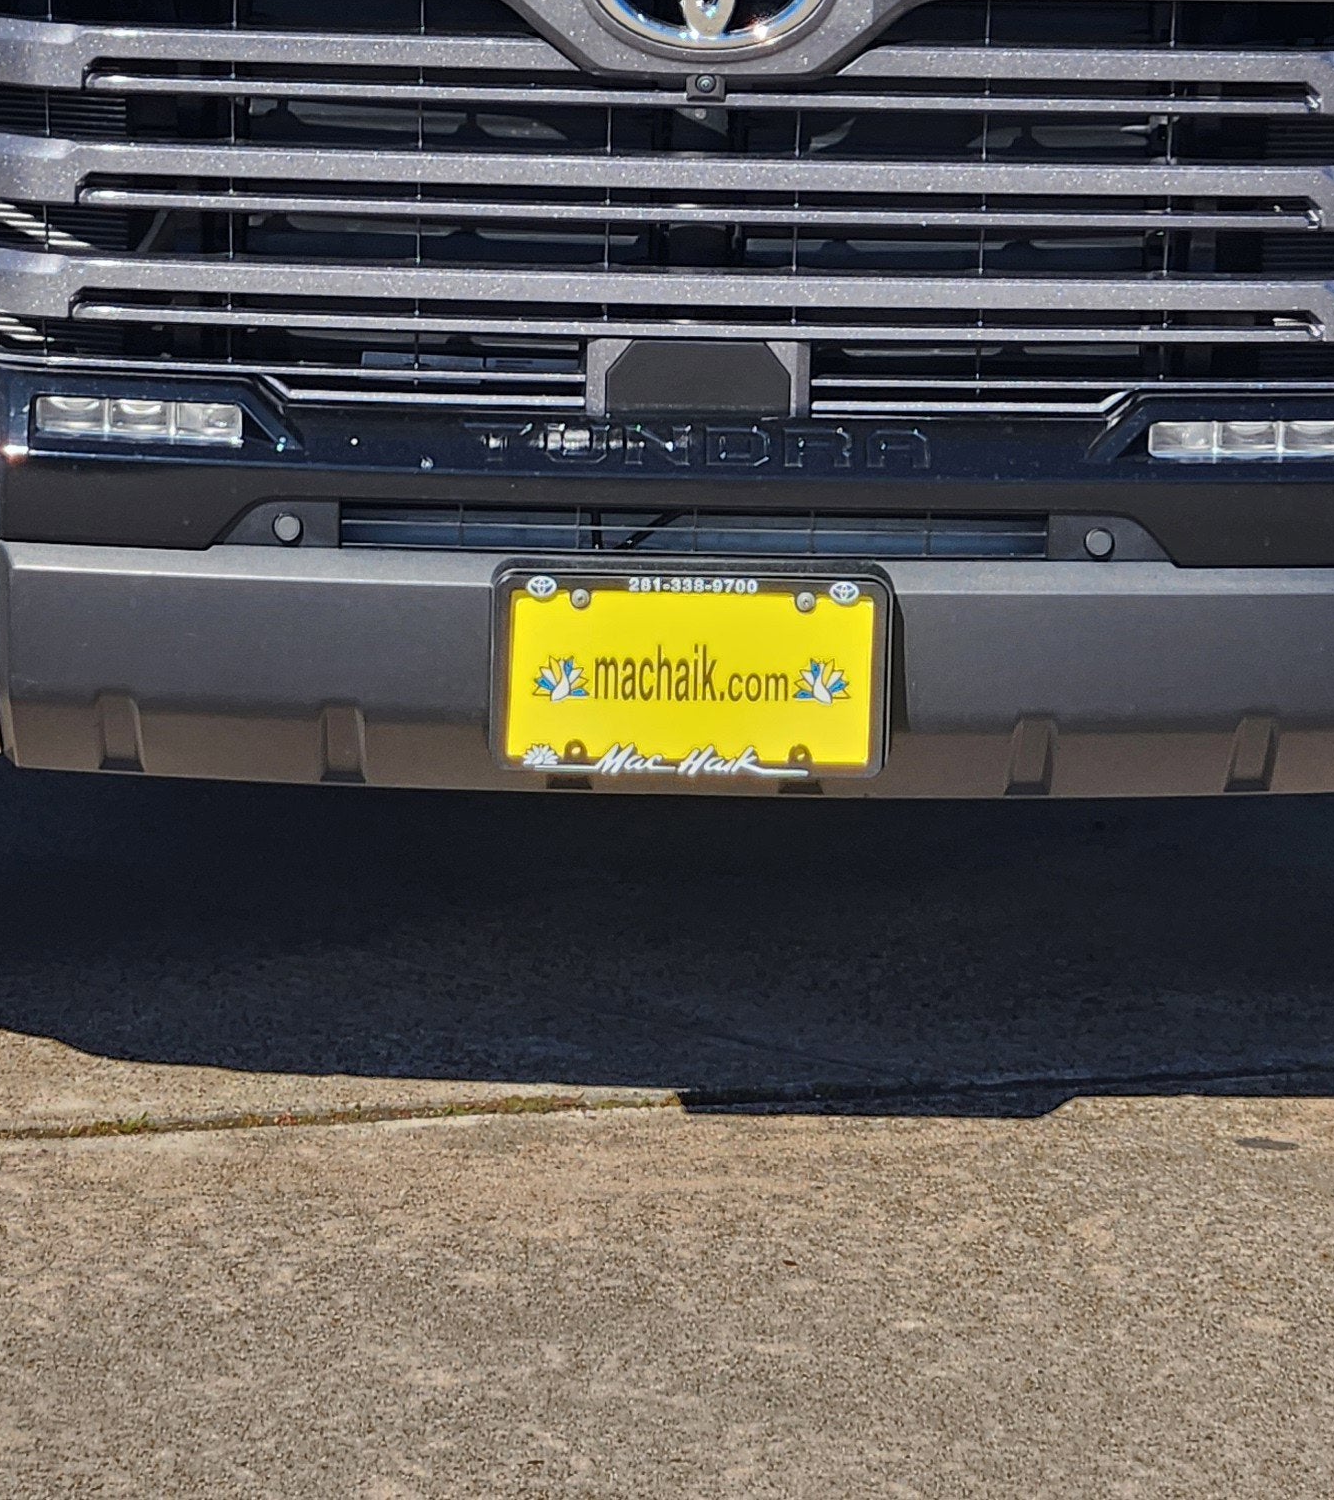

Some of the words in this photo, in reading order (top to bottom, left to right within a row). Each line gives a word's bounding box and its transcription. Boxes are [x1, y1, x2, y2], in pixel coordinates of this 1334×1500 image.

[464, 422, 930, 466] TUNDRA
[594, 644, 789, 702] machaik.com
[595, 742, 675, 775] Mac
